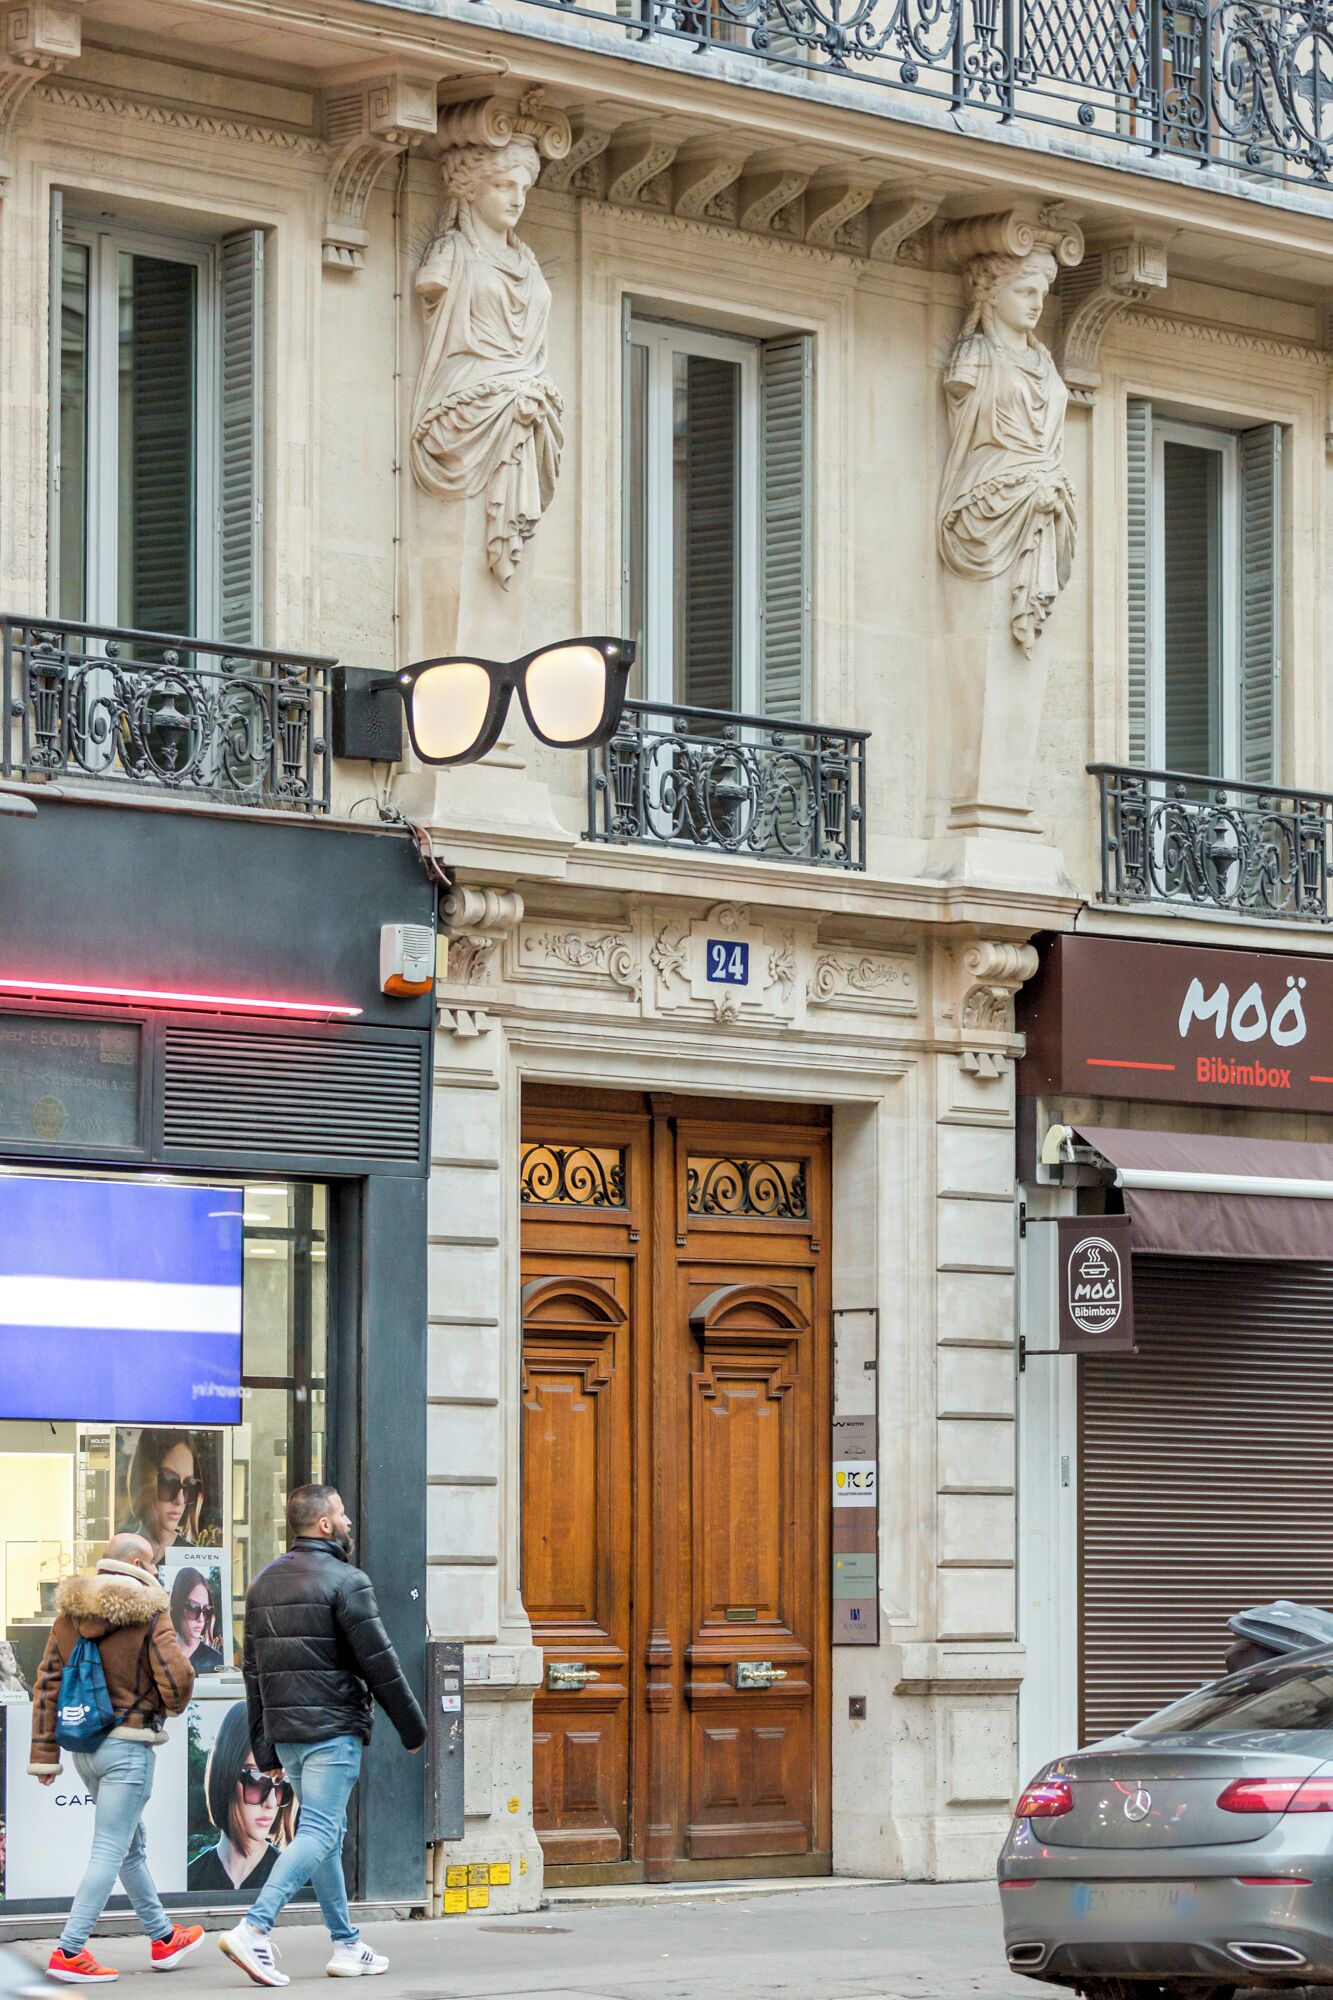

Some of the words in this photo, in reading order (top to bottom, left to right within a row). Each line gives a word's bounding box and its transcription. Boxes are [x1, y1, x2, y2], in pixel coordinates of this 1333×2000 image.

[712, 944, 744, 980] 24
[1178, 975, 1307, 1047] MOÖ
[30, 1030, 90, 1047] ESCADA
[1196, 1056, 1291, 1089] Bibimbox
[1074, 1278, 1116, 1300] MOÖ
[1074, 1304, 1117, 1317] Bibimbox
